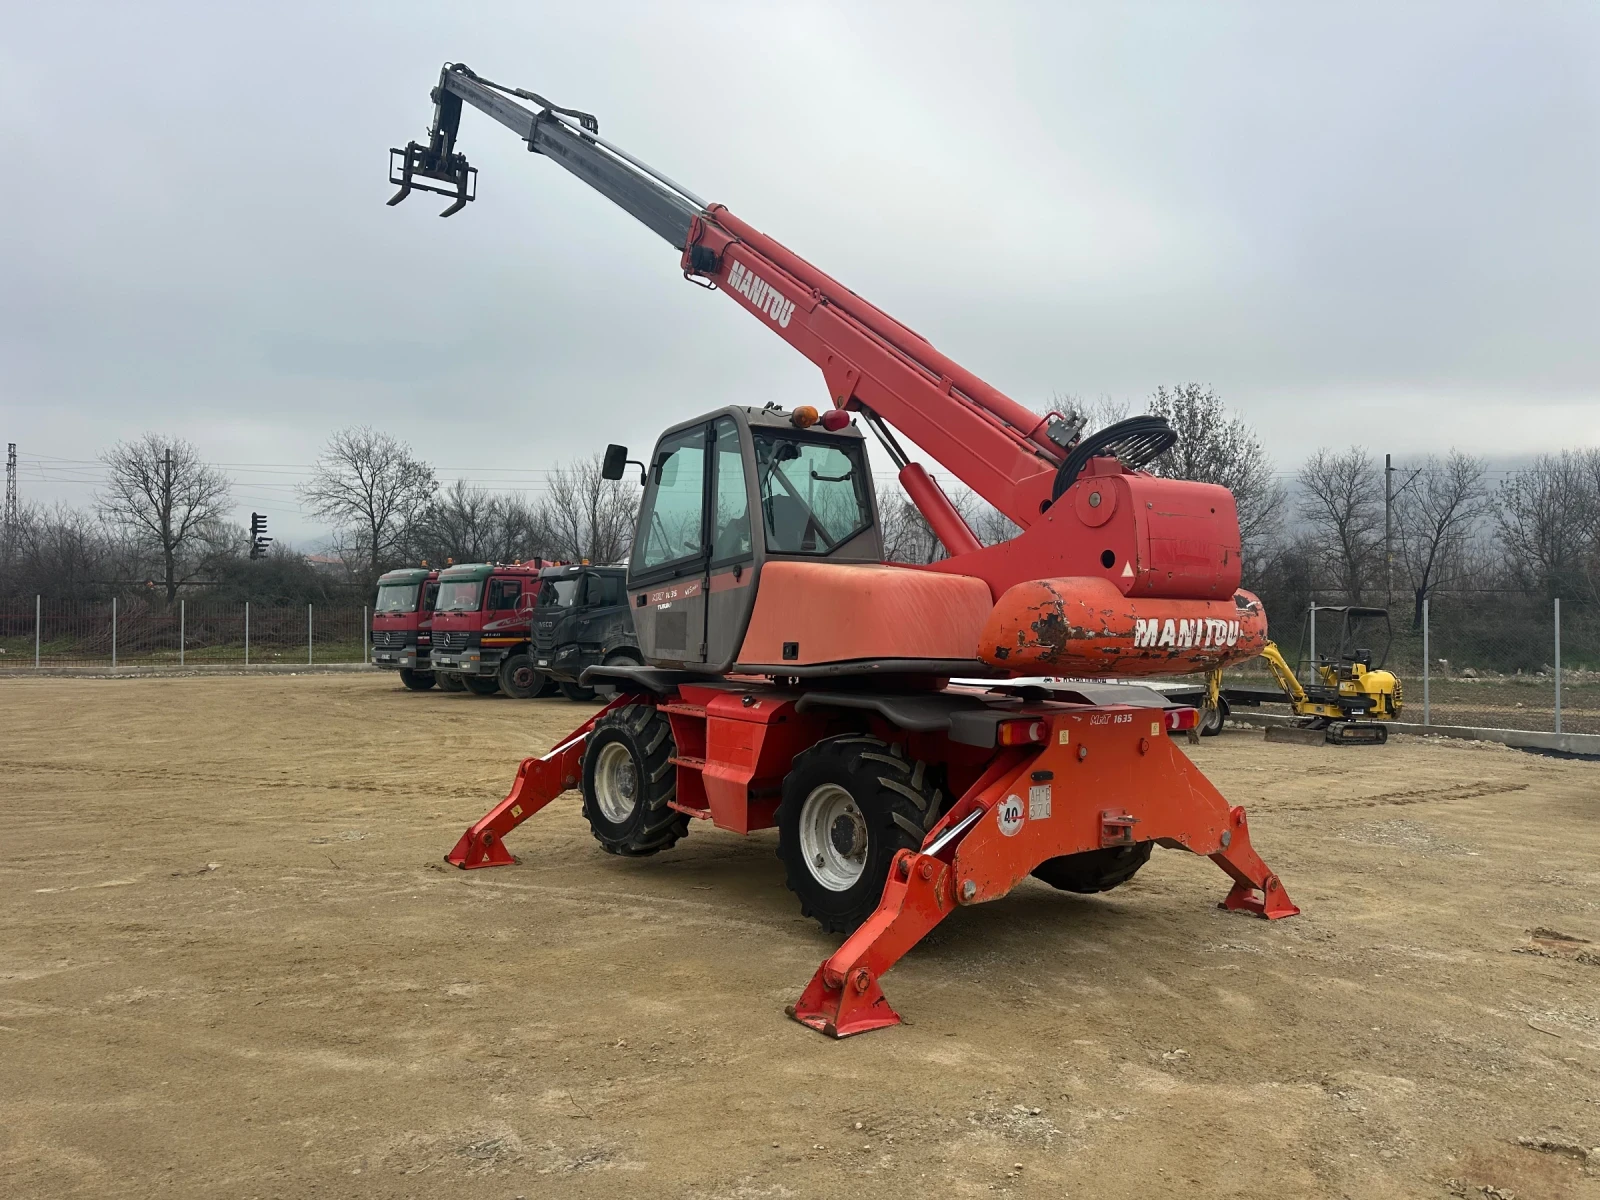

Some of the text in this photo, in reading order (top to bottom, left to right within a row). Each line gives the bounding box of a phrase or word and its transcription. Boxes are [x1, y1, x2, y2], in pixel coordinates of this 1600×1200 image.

[727, 259, 796, 329] MANITOU
[1134, 617, 1240, 648] MANITOU
[1090, 713, 1133, 725] MRT 1635
[1004, 806, 1018, 823] 40
